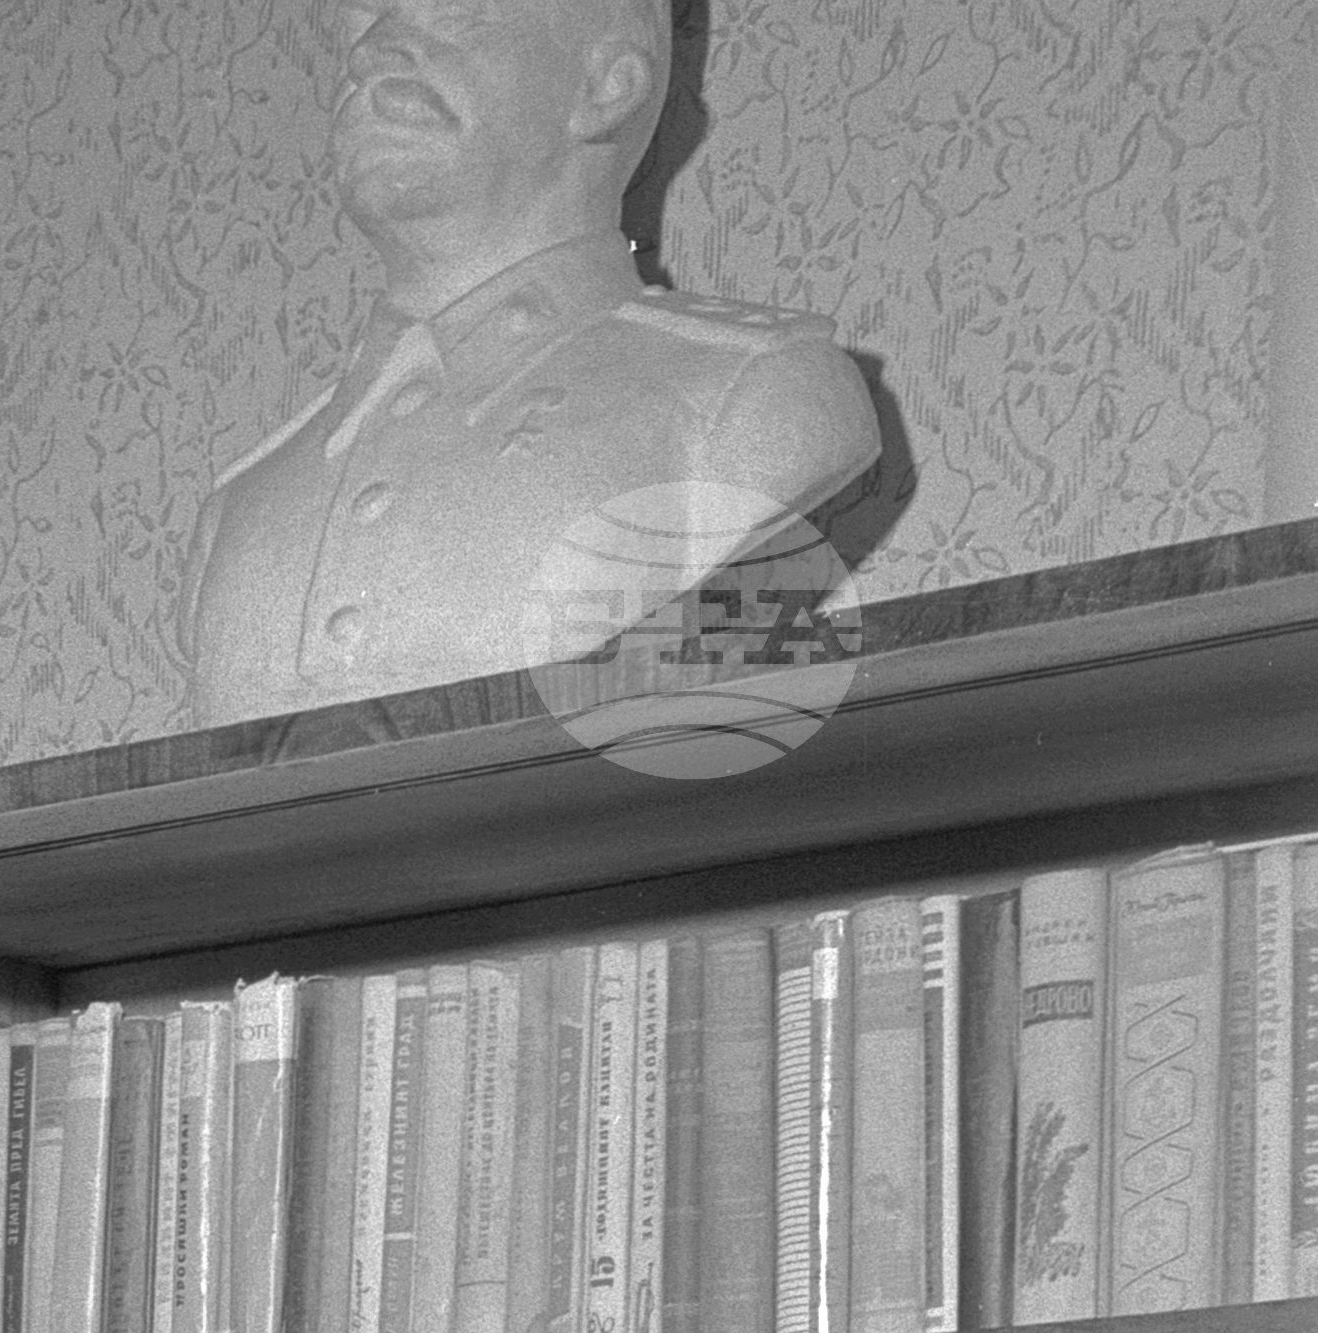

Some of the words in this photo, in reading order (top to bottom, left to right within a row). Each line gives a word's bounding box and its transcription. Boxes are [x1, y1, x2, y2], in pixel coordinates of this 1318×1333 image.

[399, 1013, 416, 1071] ГРАД
[646, 966, 658, 1083] РОДИНАТА
[12, 1066, 27, 1119] ГИБЕЛ
[556, 1045, 573, 1178] ВЕЛКОВ
[644, 1091, 656, 1119] НА
[10, 1129, 25, 1173] ПРЕД
[178, 1113, 191, 1184] РОМАН
[390, 1079, 412, 1216] ЖЕЛЕЗНИЯТ
[642, 1126, 655, 1208] ЧЕСТТА
[7, 1181, 22, 1246] ЗЕМЯТА
